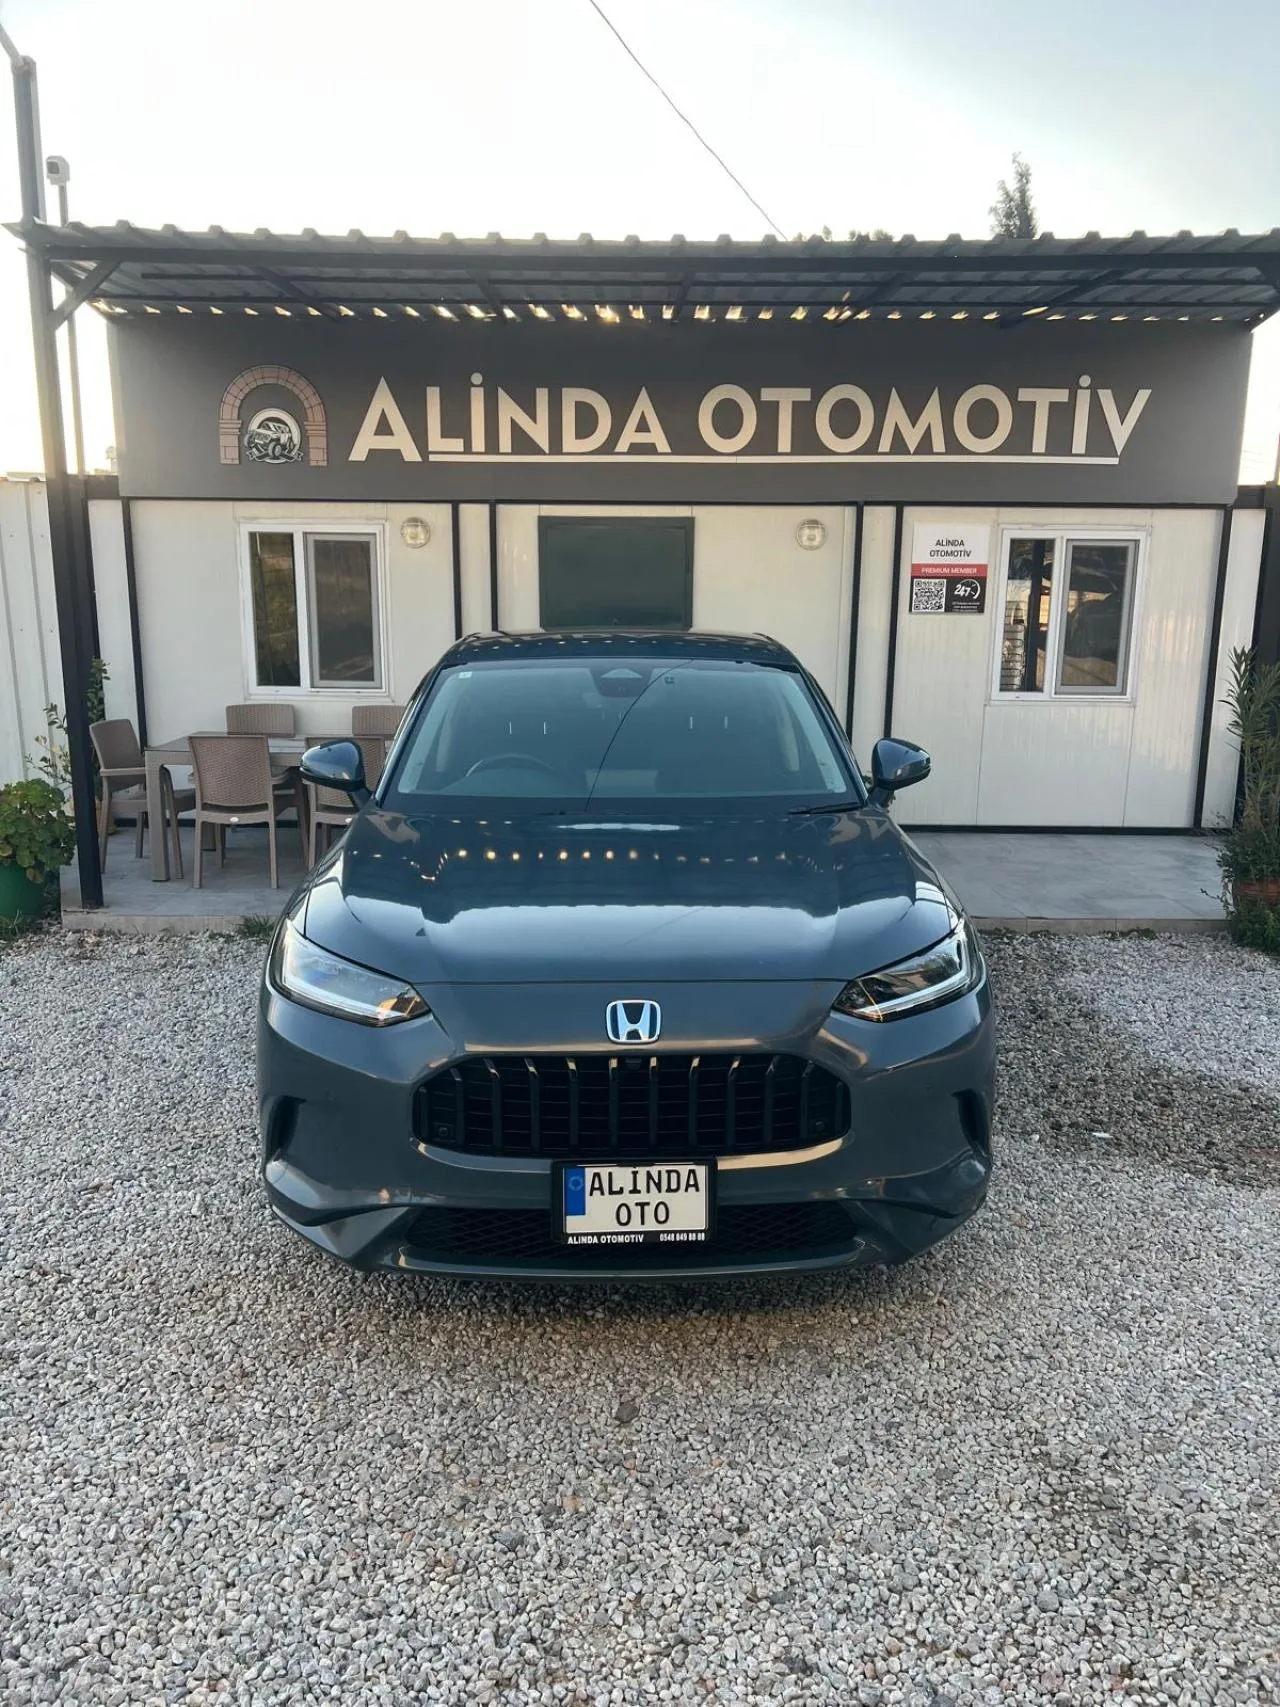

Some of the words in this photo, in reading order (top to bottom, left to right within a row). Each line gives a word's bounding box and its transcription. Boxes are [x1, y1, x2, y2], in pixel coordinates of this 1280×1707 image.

[348, 372, 672, 462] ALİNDA
[698, 373, 1153, 456] OTOMOTİV
[615, 1201, 670, 1227] OTO
